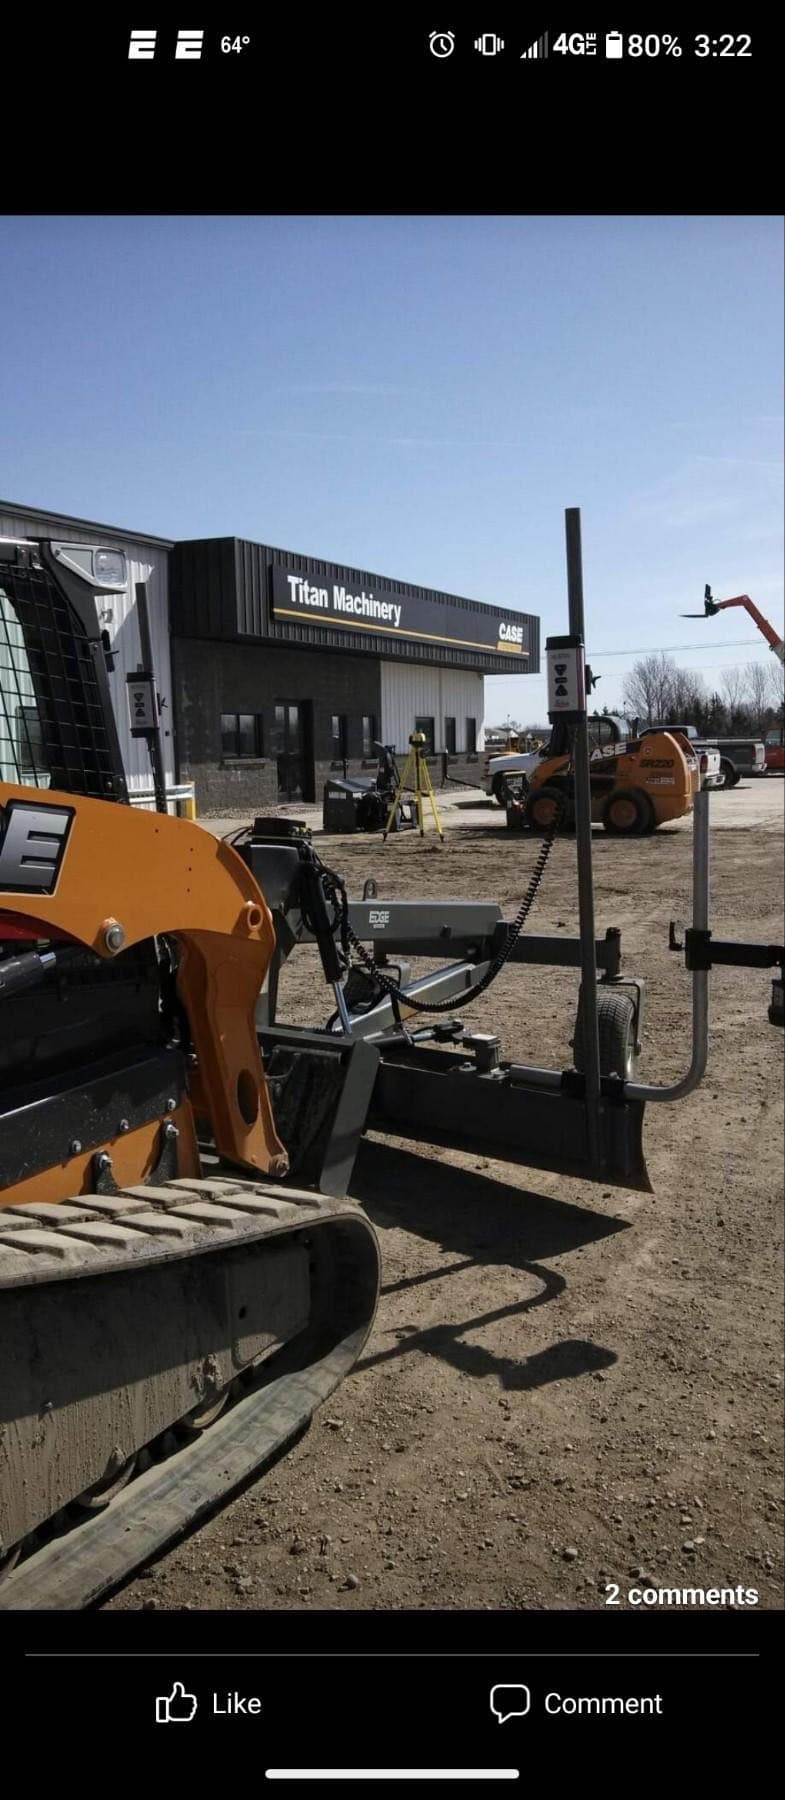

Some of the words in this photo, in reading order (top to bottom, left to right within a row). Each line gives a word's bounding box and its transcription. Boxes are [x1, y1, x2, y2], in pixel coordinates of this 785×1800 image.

[287, 575, 329, 608] Titan
[333, 585, 402, 627] Machinery
[498, 622, 524, 643] CASE
[590, 742, 627, 762] ASE
[369, 910, 390, 924] EDGE
